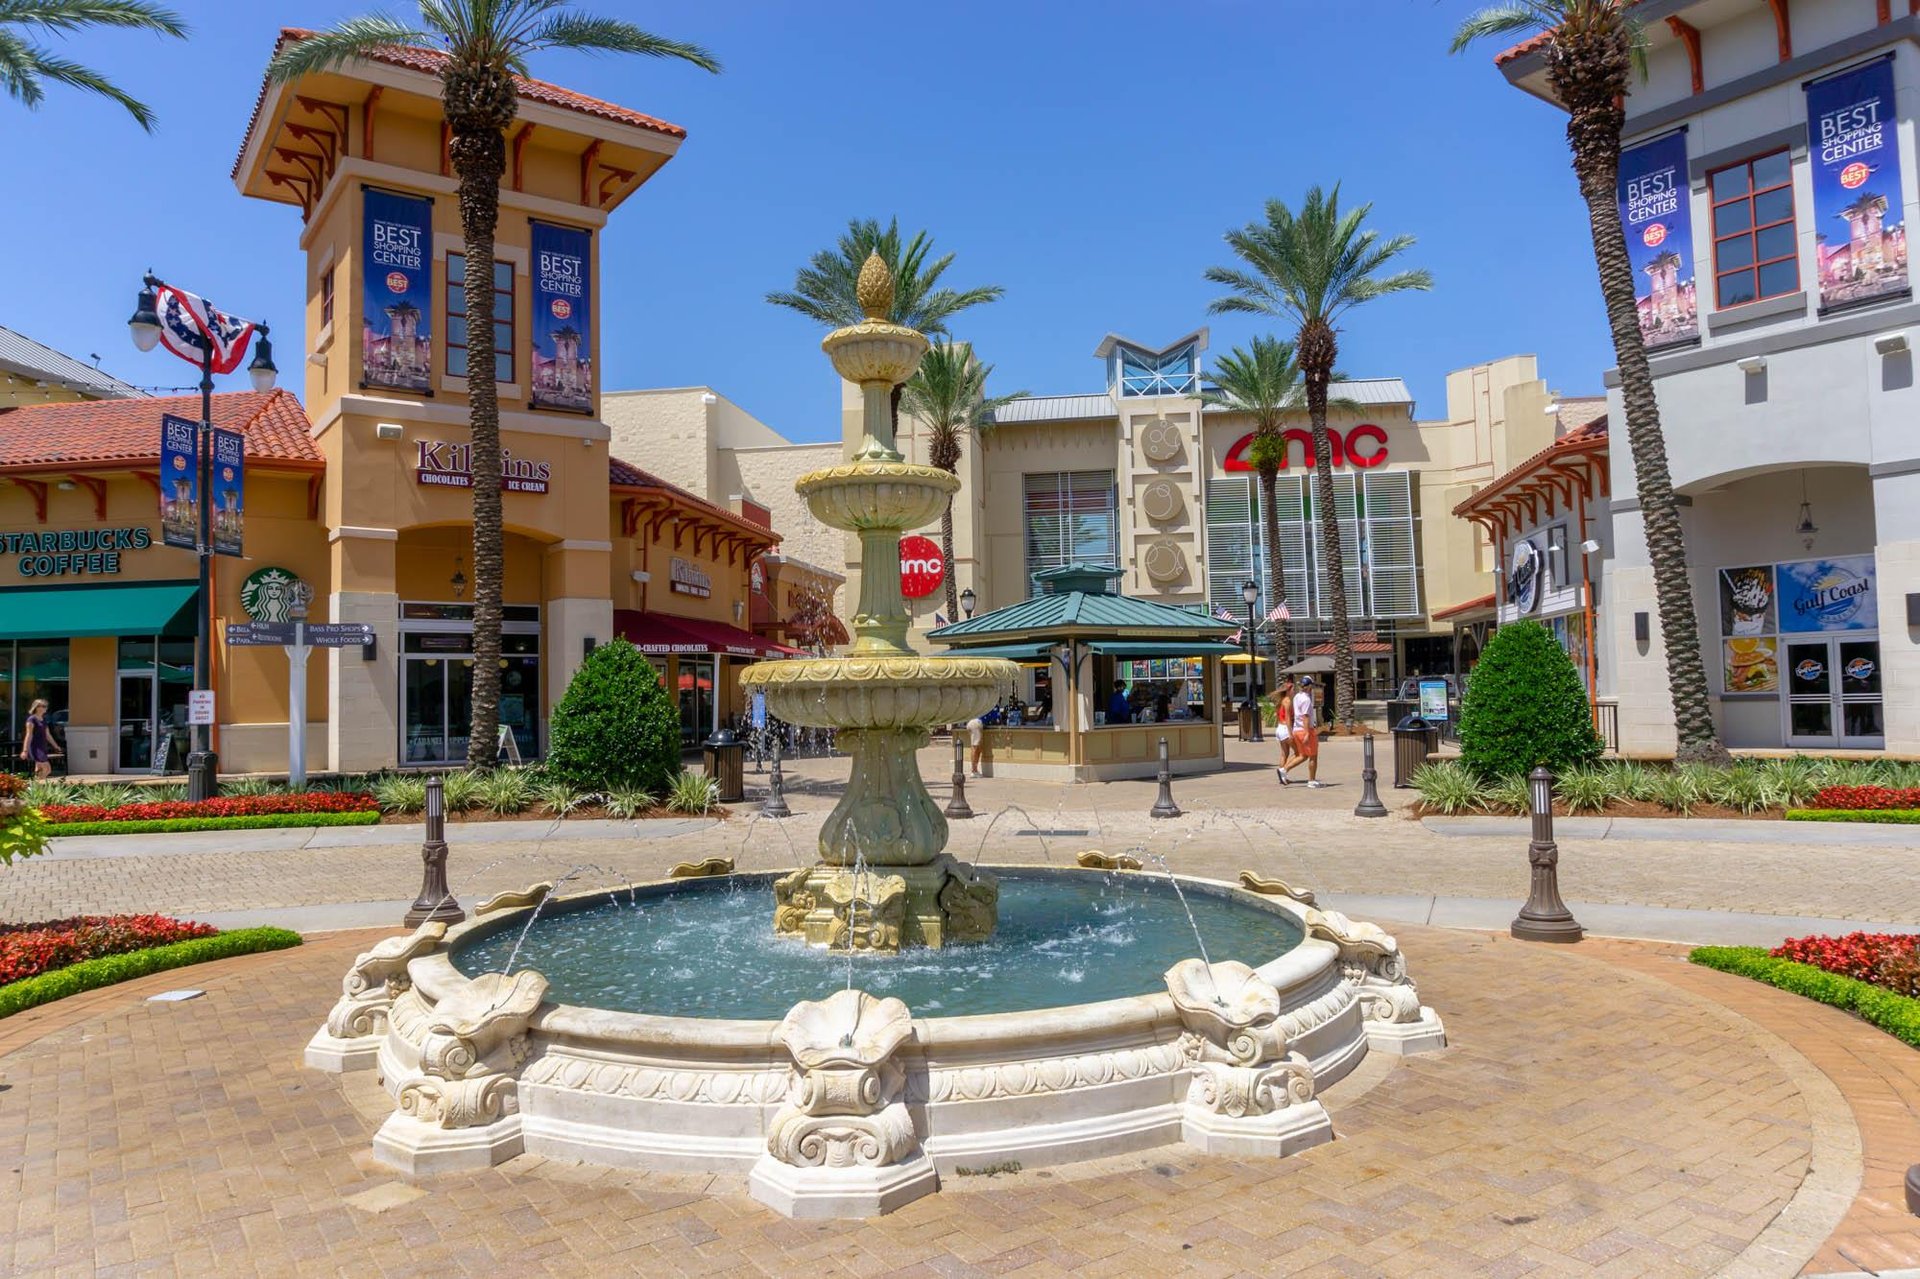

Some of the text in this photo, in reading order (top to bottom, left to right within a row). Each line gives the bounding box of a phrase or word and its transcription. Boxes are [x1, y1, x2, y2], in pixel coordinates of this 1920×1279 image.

[1821, 101, 1880, 139] BEST
[1822, 122, 1882, 149] SHOPPING
[1822, 133, 1882, 161] CENTER
[1841, 168, 1868, 183] BEST
[1628, 170, 1675, 201] BEST
[1629, 188, 1677, 210] SHOPPING
[1629, 199, 1677, 222] CENTER
[374, 224, 421, 247] BEST
[374, 241, 421, 256] SHOPPING
[373, 250, 421, 267] CENTER
[541, 254, 581, 276] BEST
[540, 271, 581, 284] SHOPPING
[540, 279, 581, 295] CENTER
[167, 422, 193, 439] BEST
[166, 440, 192, 452] CENTER
[218, 435, 240, 451] BEST
[217, 453, 240, 465] CENTER
[414, 440, 551, 480] Kilins
[421, 473, 545, 492] CHOCOLATES ICE CREAM
[0, 527, 150, 554] TARBUCKS
[17, 551, 120, 577] COFFEE
[900, 558, 942, 575] mc
[1794, 590, 1825, 616] Gulf
[1829, 578, 1869, 601] Coast
[315, 636, 361, 644] WHOLE FOODS
[671, 644, 709, 653] CHOCOLATES
